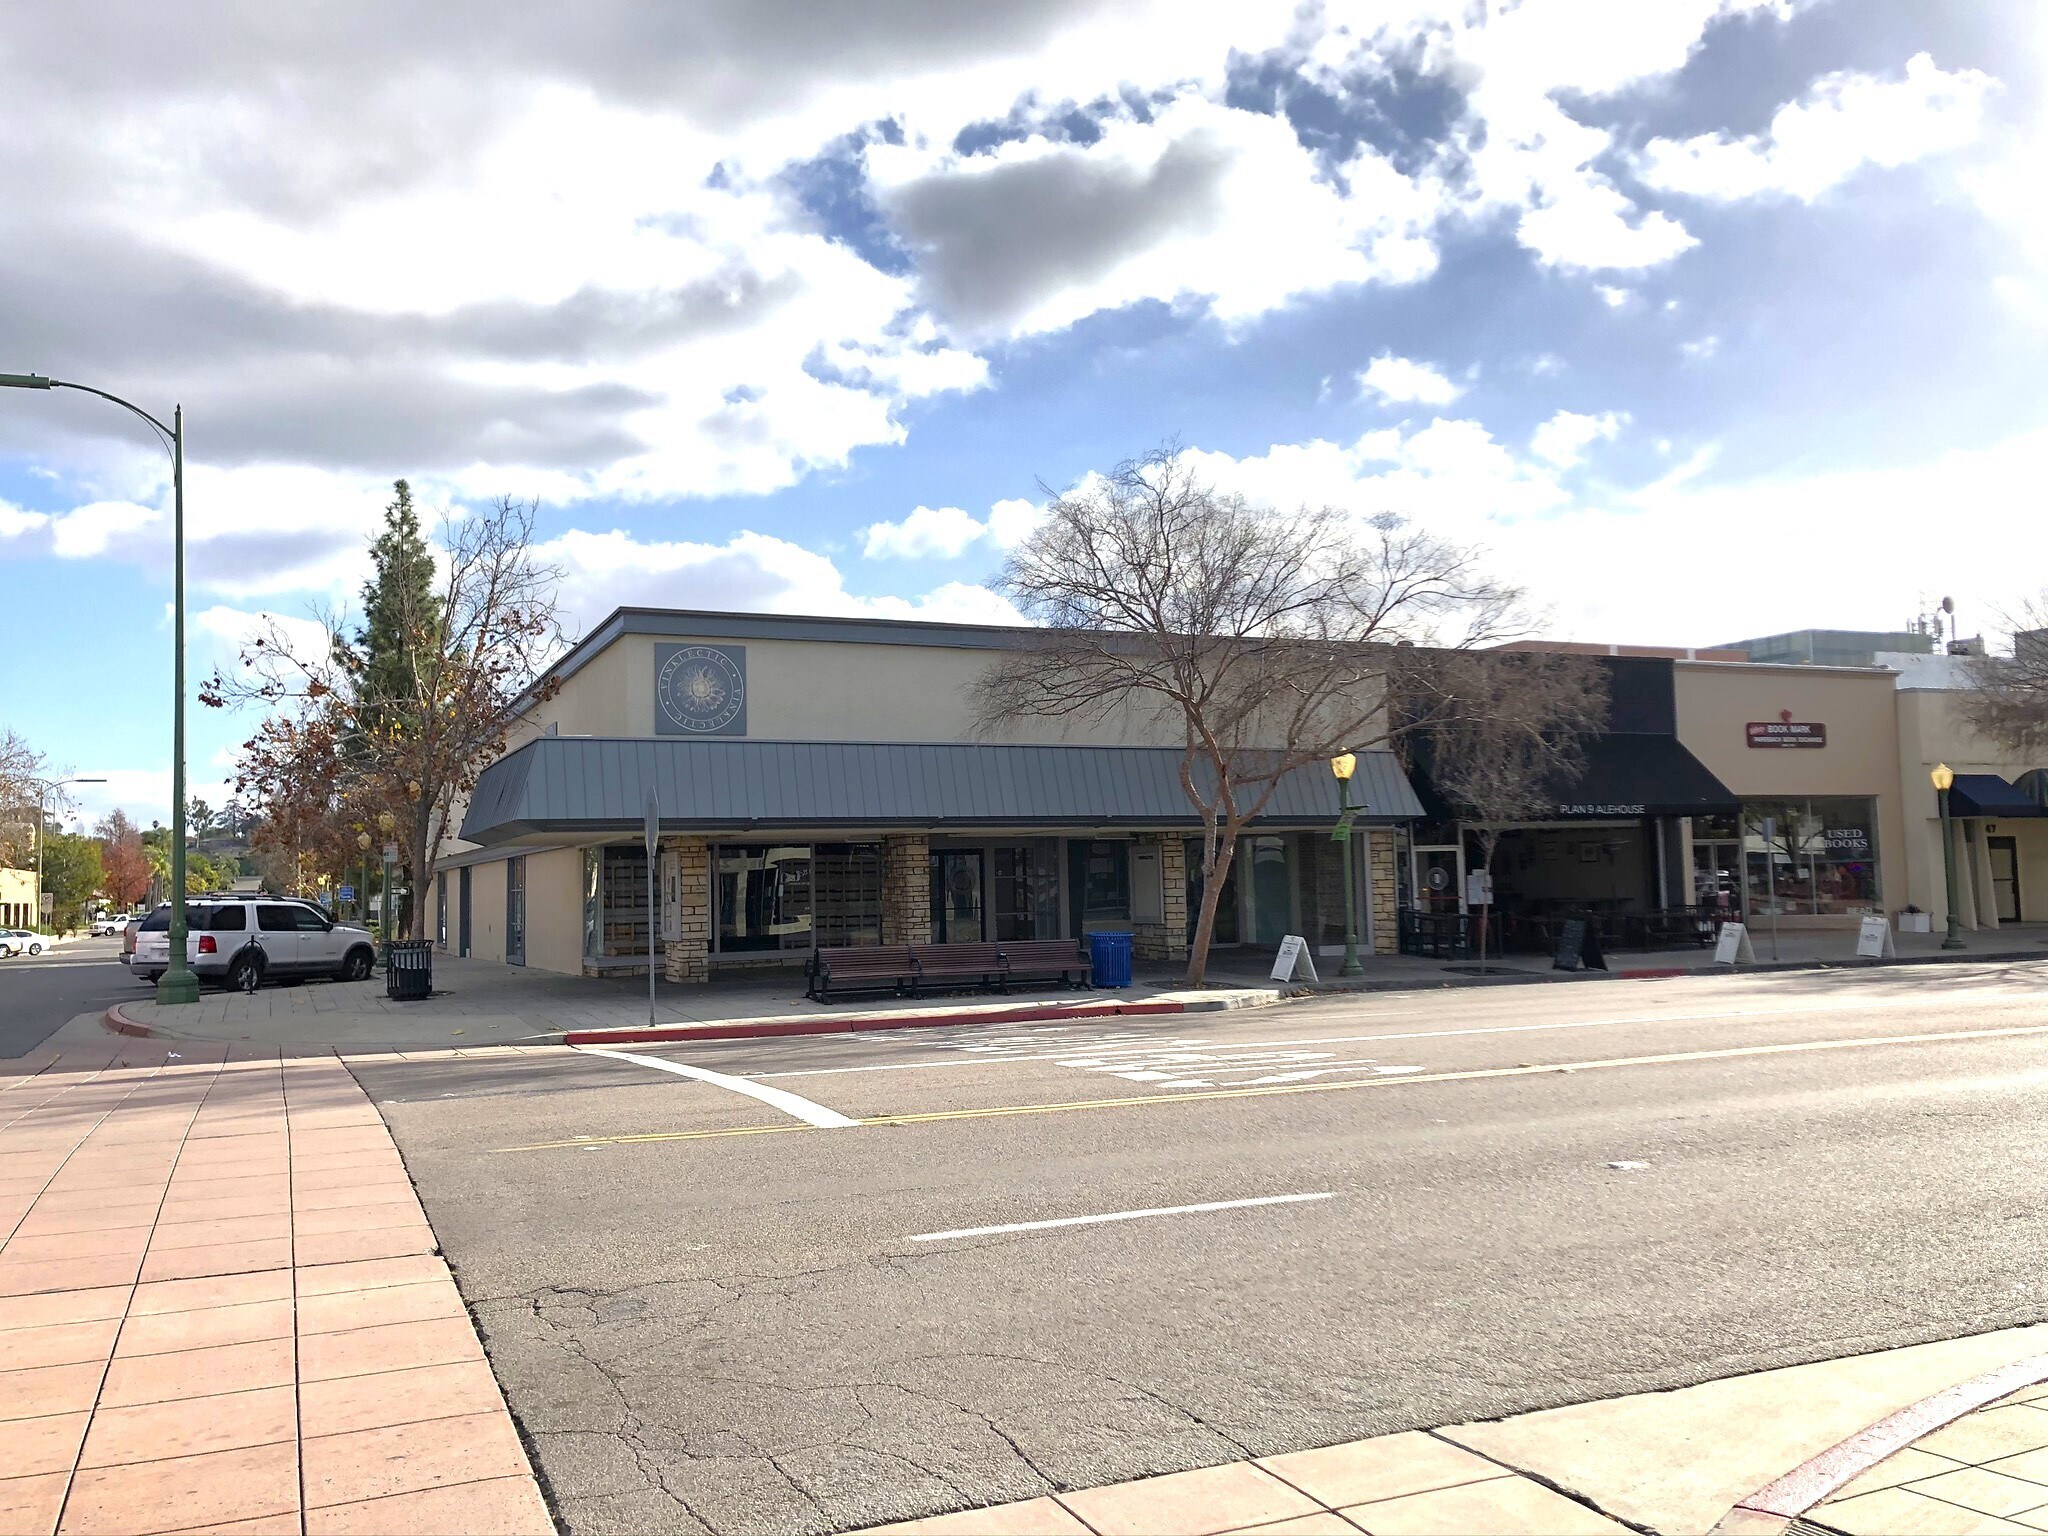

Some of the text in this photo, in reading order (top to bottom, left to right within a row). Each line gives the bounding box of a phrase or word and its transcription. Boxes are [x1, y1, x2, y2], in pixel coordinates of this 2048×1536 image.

[661, 649, 728, 690] VINKLECTIC
[674, 689, 741, 728] VINKLECTIC
[1767, 725, 1789, 733] BOOK
[1790, 725, 1811, 733] MARK
[1560, 804, 1646, 814] PLAN 9 ALEHOUSE
[1827, 828, 1863, 838] USED
[1824, 838, 1868, 848] BOOKS
